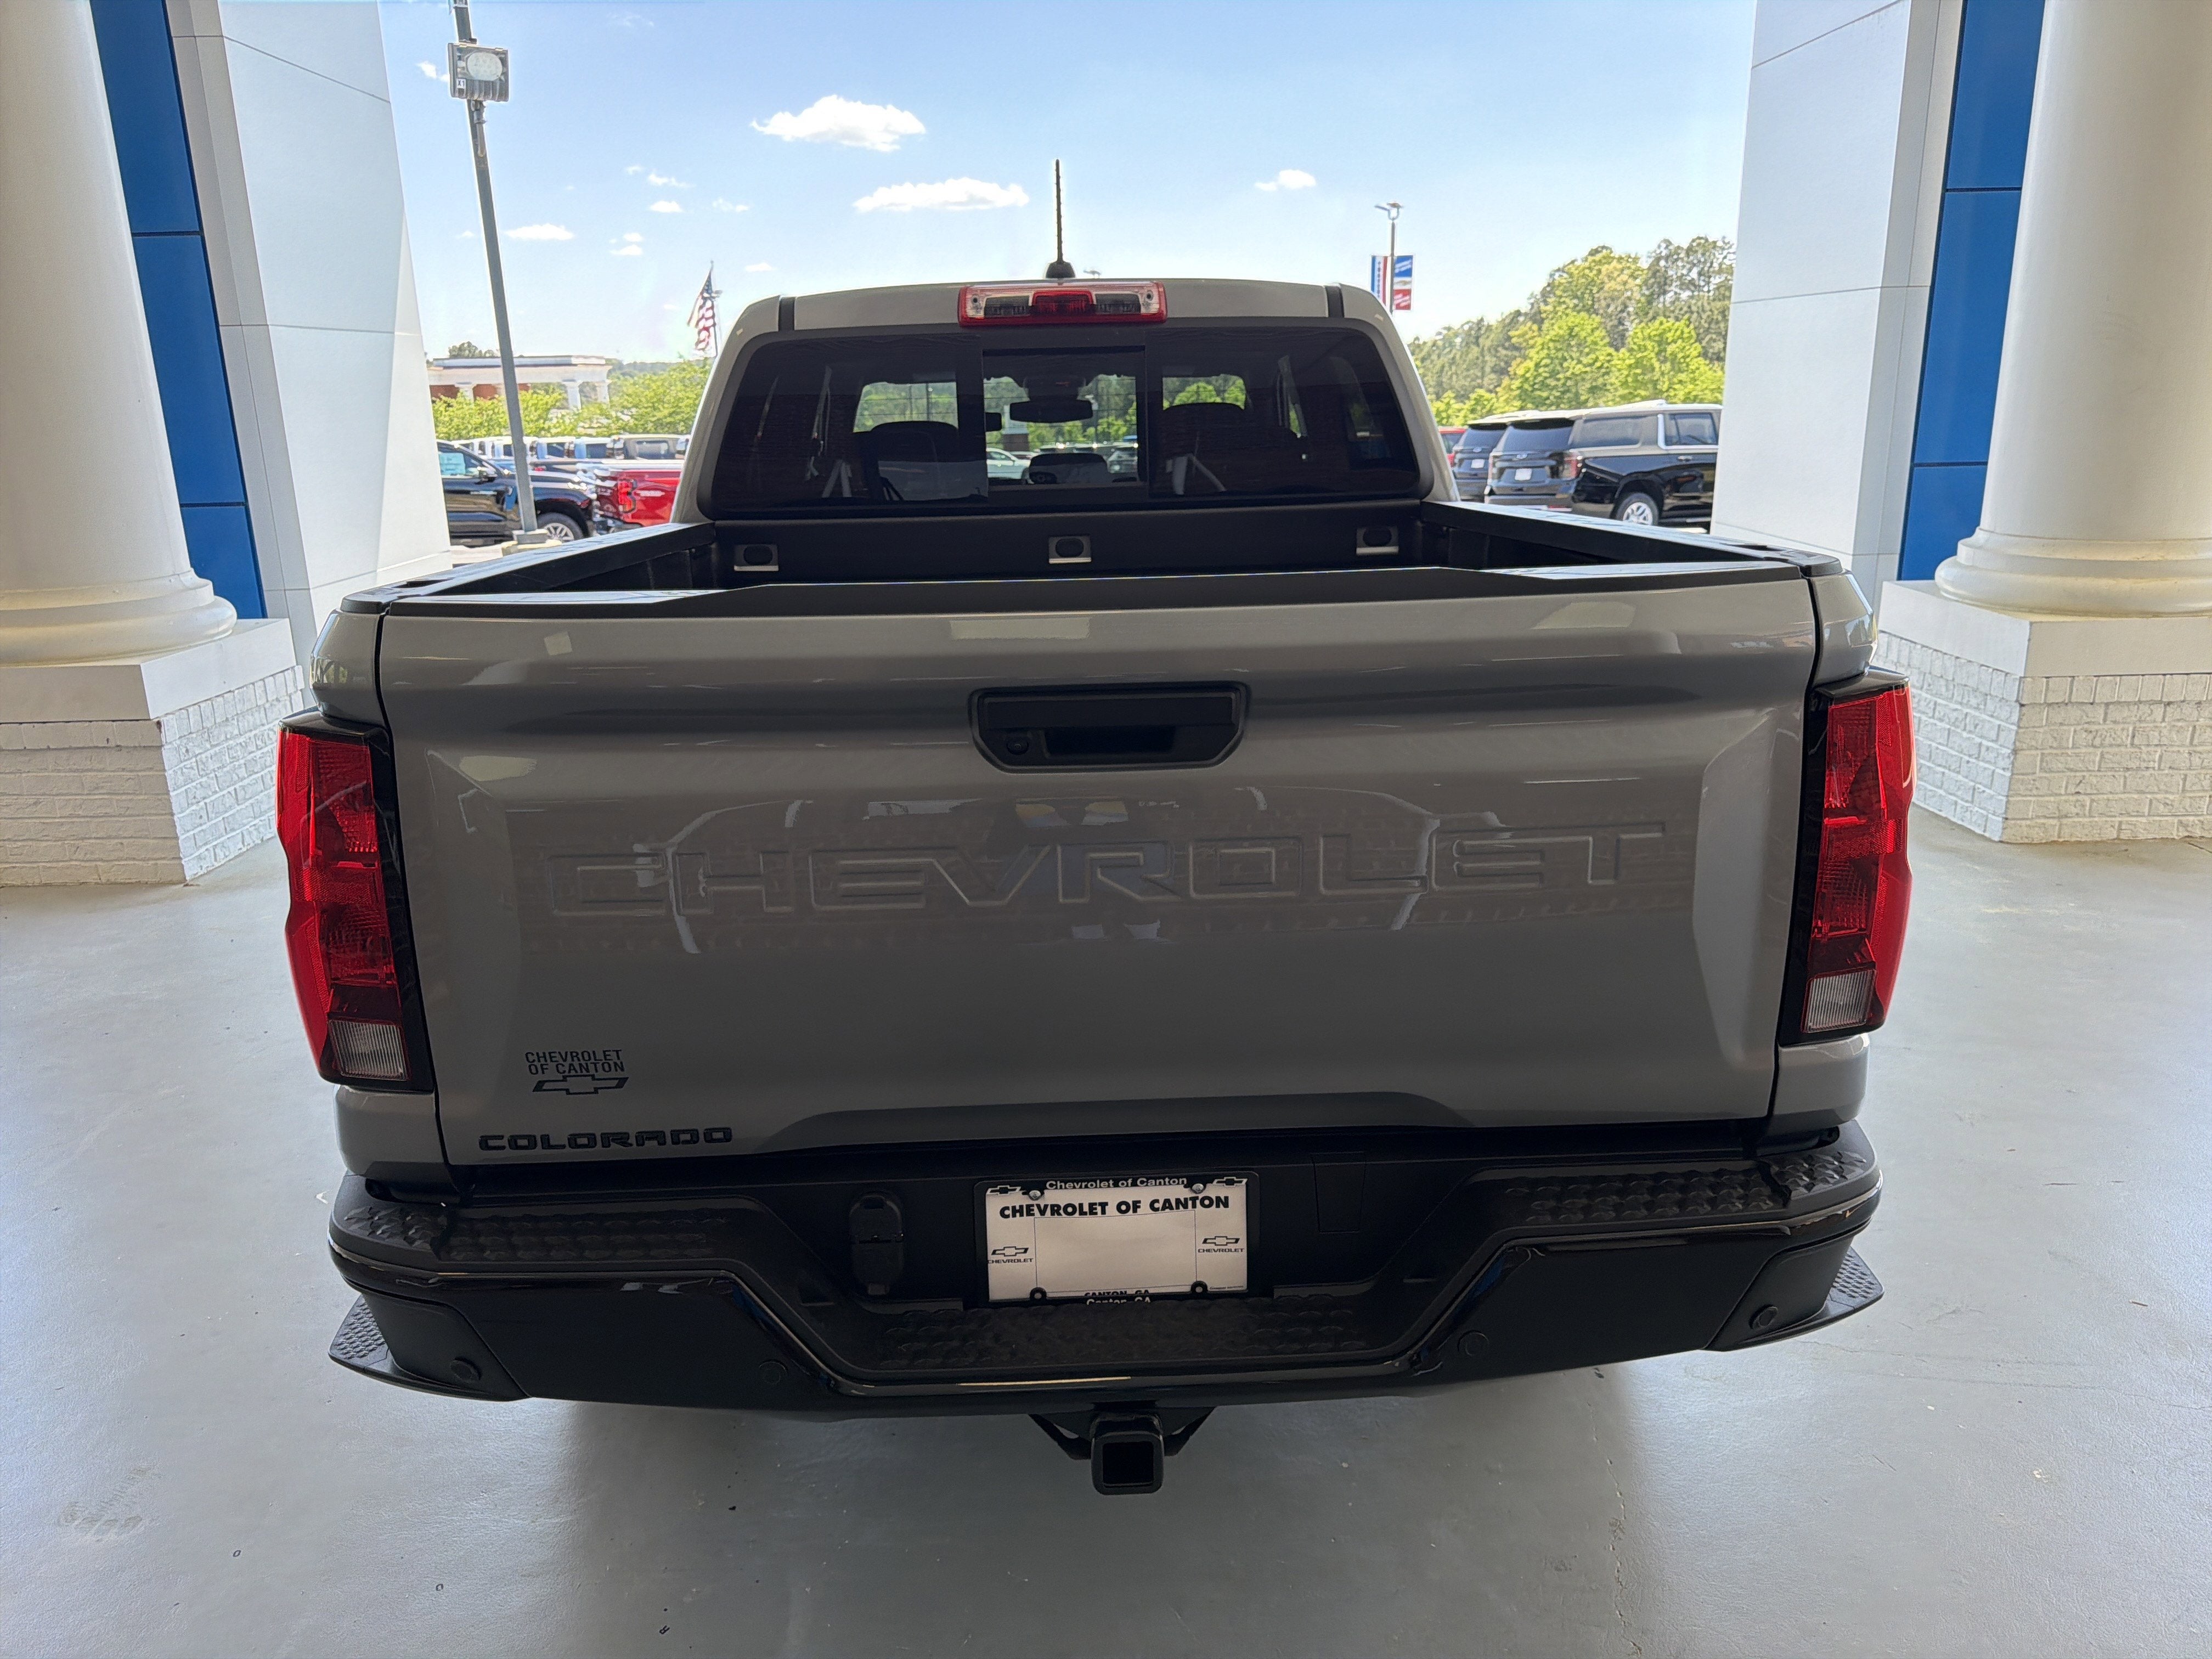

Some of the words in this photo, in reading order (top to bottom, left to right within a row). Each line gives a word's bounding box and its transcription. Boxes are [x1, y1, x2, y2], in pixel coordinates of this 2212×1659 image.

[549, 823, 1664, 916] CHEVROLET
[525, 1049, 622, 1064] CHEVROLET
[528, 1062, 549, 1075] OF
[556, 1062, 625, 1074] CANTON
[479, 1127, 732, 1151] COLORADO
[1046, 1180, 1114, 1190] Chevrolet
[1119, 1179, 1132, 1188] of
[1137, 1177, 1187, 1187] Canton
[999, 1201, 1109, 1218] CHEVROLET
[1116, 1200, 1141, 1214] OF
[1149, 1195, 1229, 1212] CANTON
